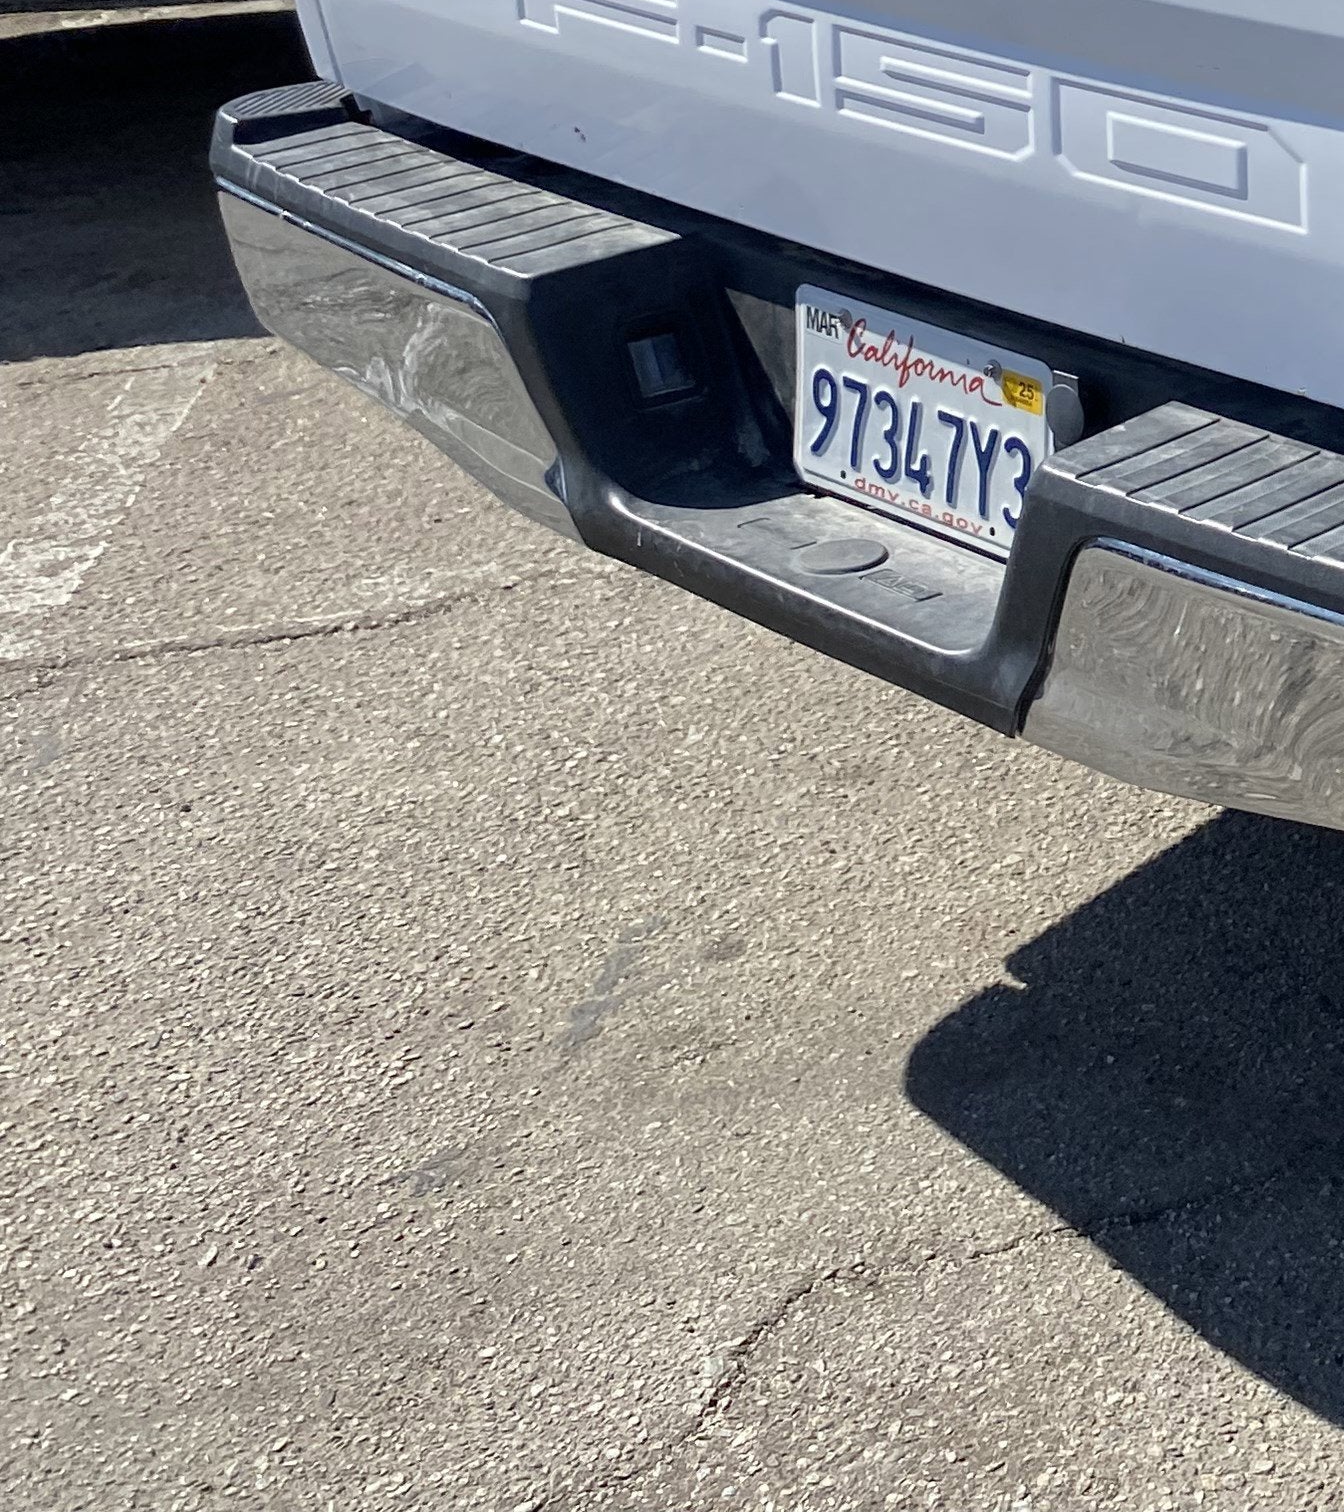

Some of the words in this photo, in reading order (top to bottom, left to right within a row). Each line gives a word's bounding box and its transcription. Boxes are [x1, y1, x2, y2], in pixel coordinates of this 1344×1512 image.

[806, 305, 840, 340] MAR
[846, 318, 1003, 407] California
[1018, 381, 1035, 401] 25
[810, 367, 1032, 531] 97347Y3
[853, 476, 983, 537] dmv.ca.gov
